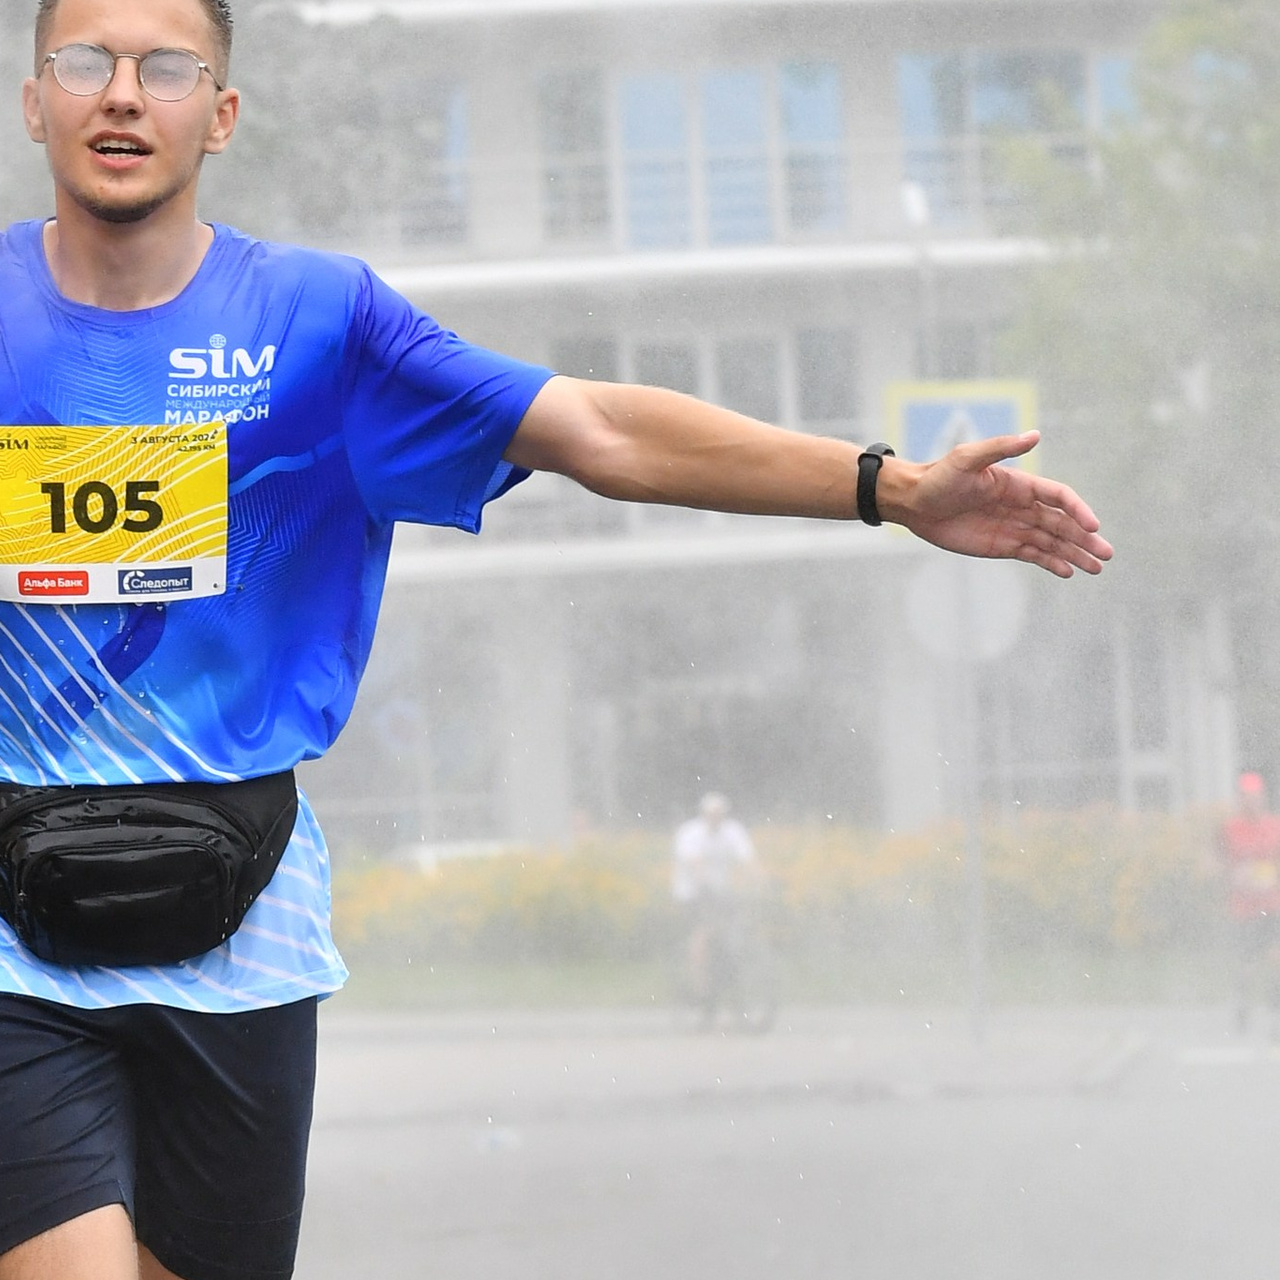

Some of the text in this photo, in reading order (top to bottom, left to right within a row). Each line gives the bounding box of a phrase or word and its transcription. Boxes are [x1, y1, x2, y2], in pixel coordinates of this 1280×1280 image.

[164, 404, 269, 425] МАРАФОН
[131, 436, 137, 445] 3
[140, 435, 190, 444] АВГУСТА
[41, 481, 163, 534] 105
[23, 577, 84, 590] Альфа Банк
[131, 578, 189, 589] Следопыт
